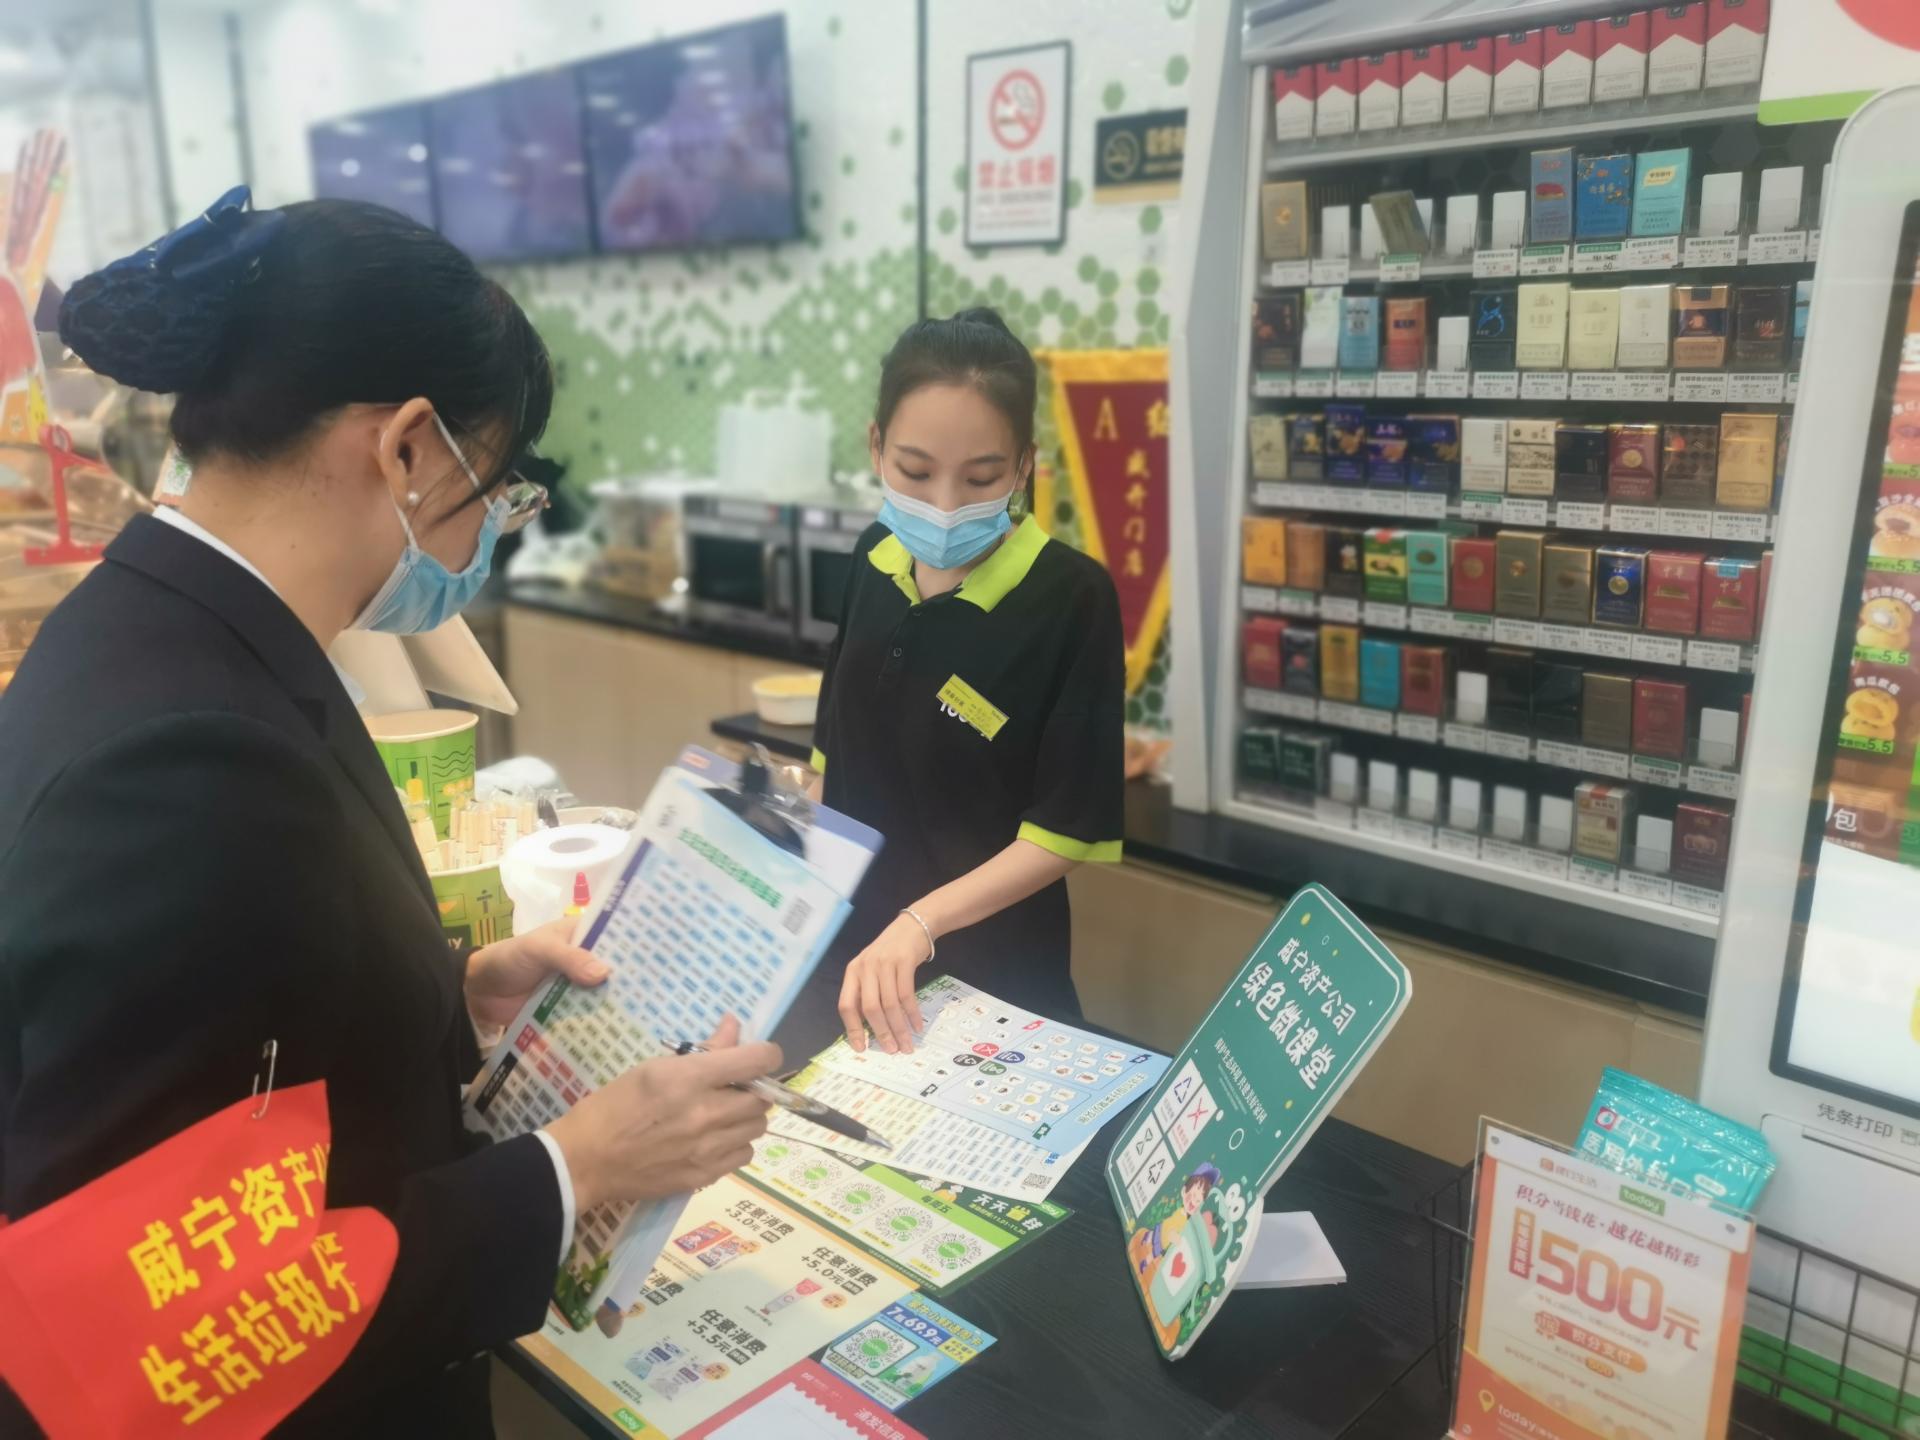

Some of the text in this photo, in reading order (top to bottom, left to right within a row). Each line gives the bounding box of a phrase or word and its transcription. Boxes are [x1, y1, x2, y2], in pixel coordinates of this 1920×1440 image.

[1277, 937, 1356, 1036] 咸宁资产公司
[1242, 961, 1336, 1091] 绿色微课堂
[1817, 1103, 1893, 1138] 凭条打印
[735, 1199, 795, 1236] 任意消费
[1621, 1187, 1662, 1213] today
[724, 1206, 760, 1232] +3.0元
[800, 1253, 844, 1286] +5.0元
[812, 1246, 878, 1288] 任意消费
[686, 1319, 732, 1354] +5.5元
[699, 1309, 768, 1356] 任意消费
